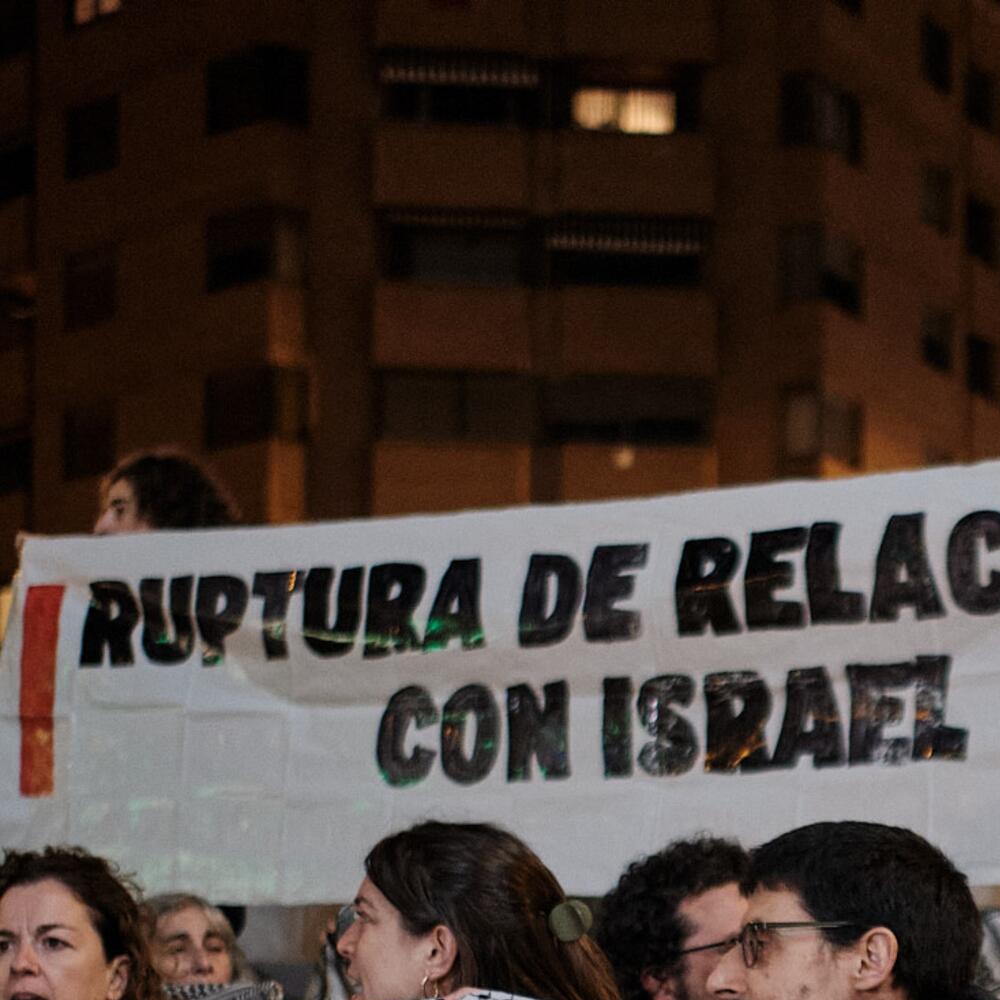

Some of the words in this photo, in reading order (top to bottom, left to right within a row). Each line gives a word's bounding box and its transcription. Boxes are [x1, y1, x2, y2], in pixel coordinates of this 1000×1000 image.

[79, 557, 485, 668] RUPTURA
[518, 542, 650, 648] DE
[376, 679, 571, 787] CON
[602, 655, 968, 777] ISRAEL
